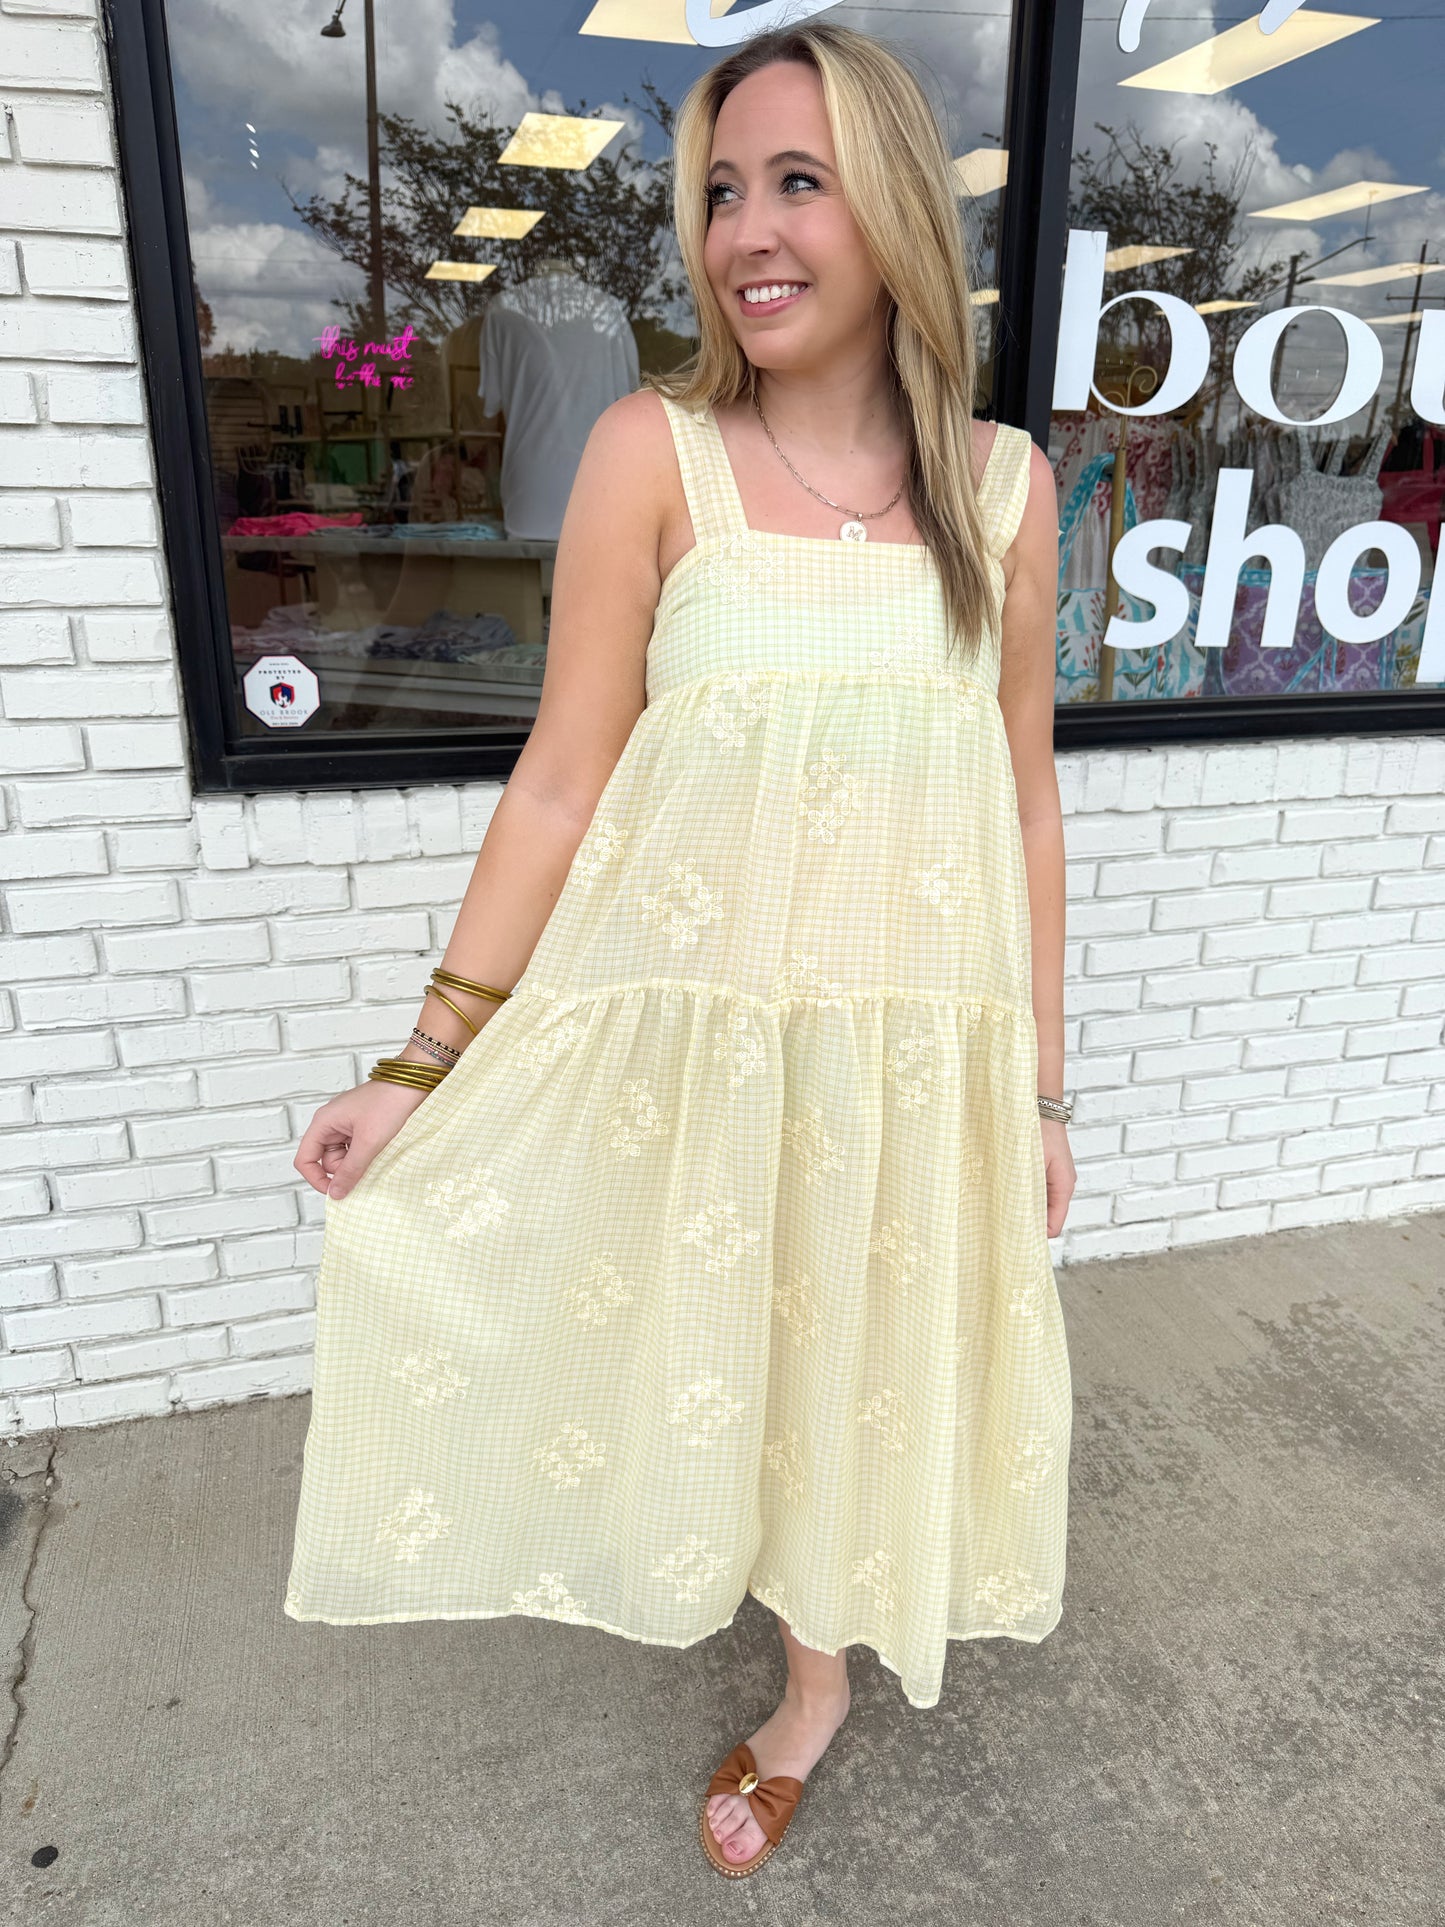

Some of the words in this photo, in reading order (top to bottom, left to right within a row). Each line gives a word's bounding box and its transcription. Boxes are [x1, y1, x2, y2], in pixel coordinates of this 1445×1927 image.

[312, 324, 359, 361] this
[363, 324, 420, 361] must
[1103, 468, 1445, 683] sho
